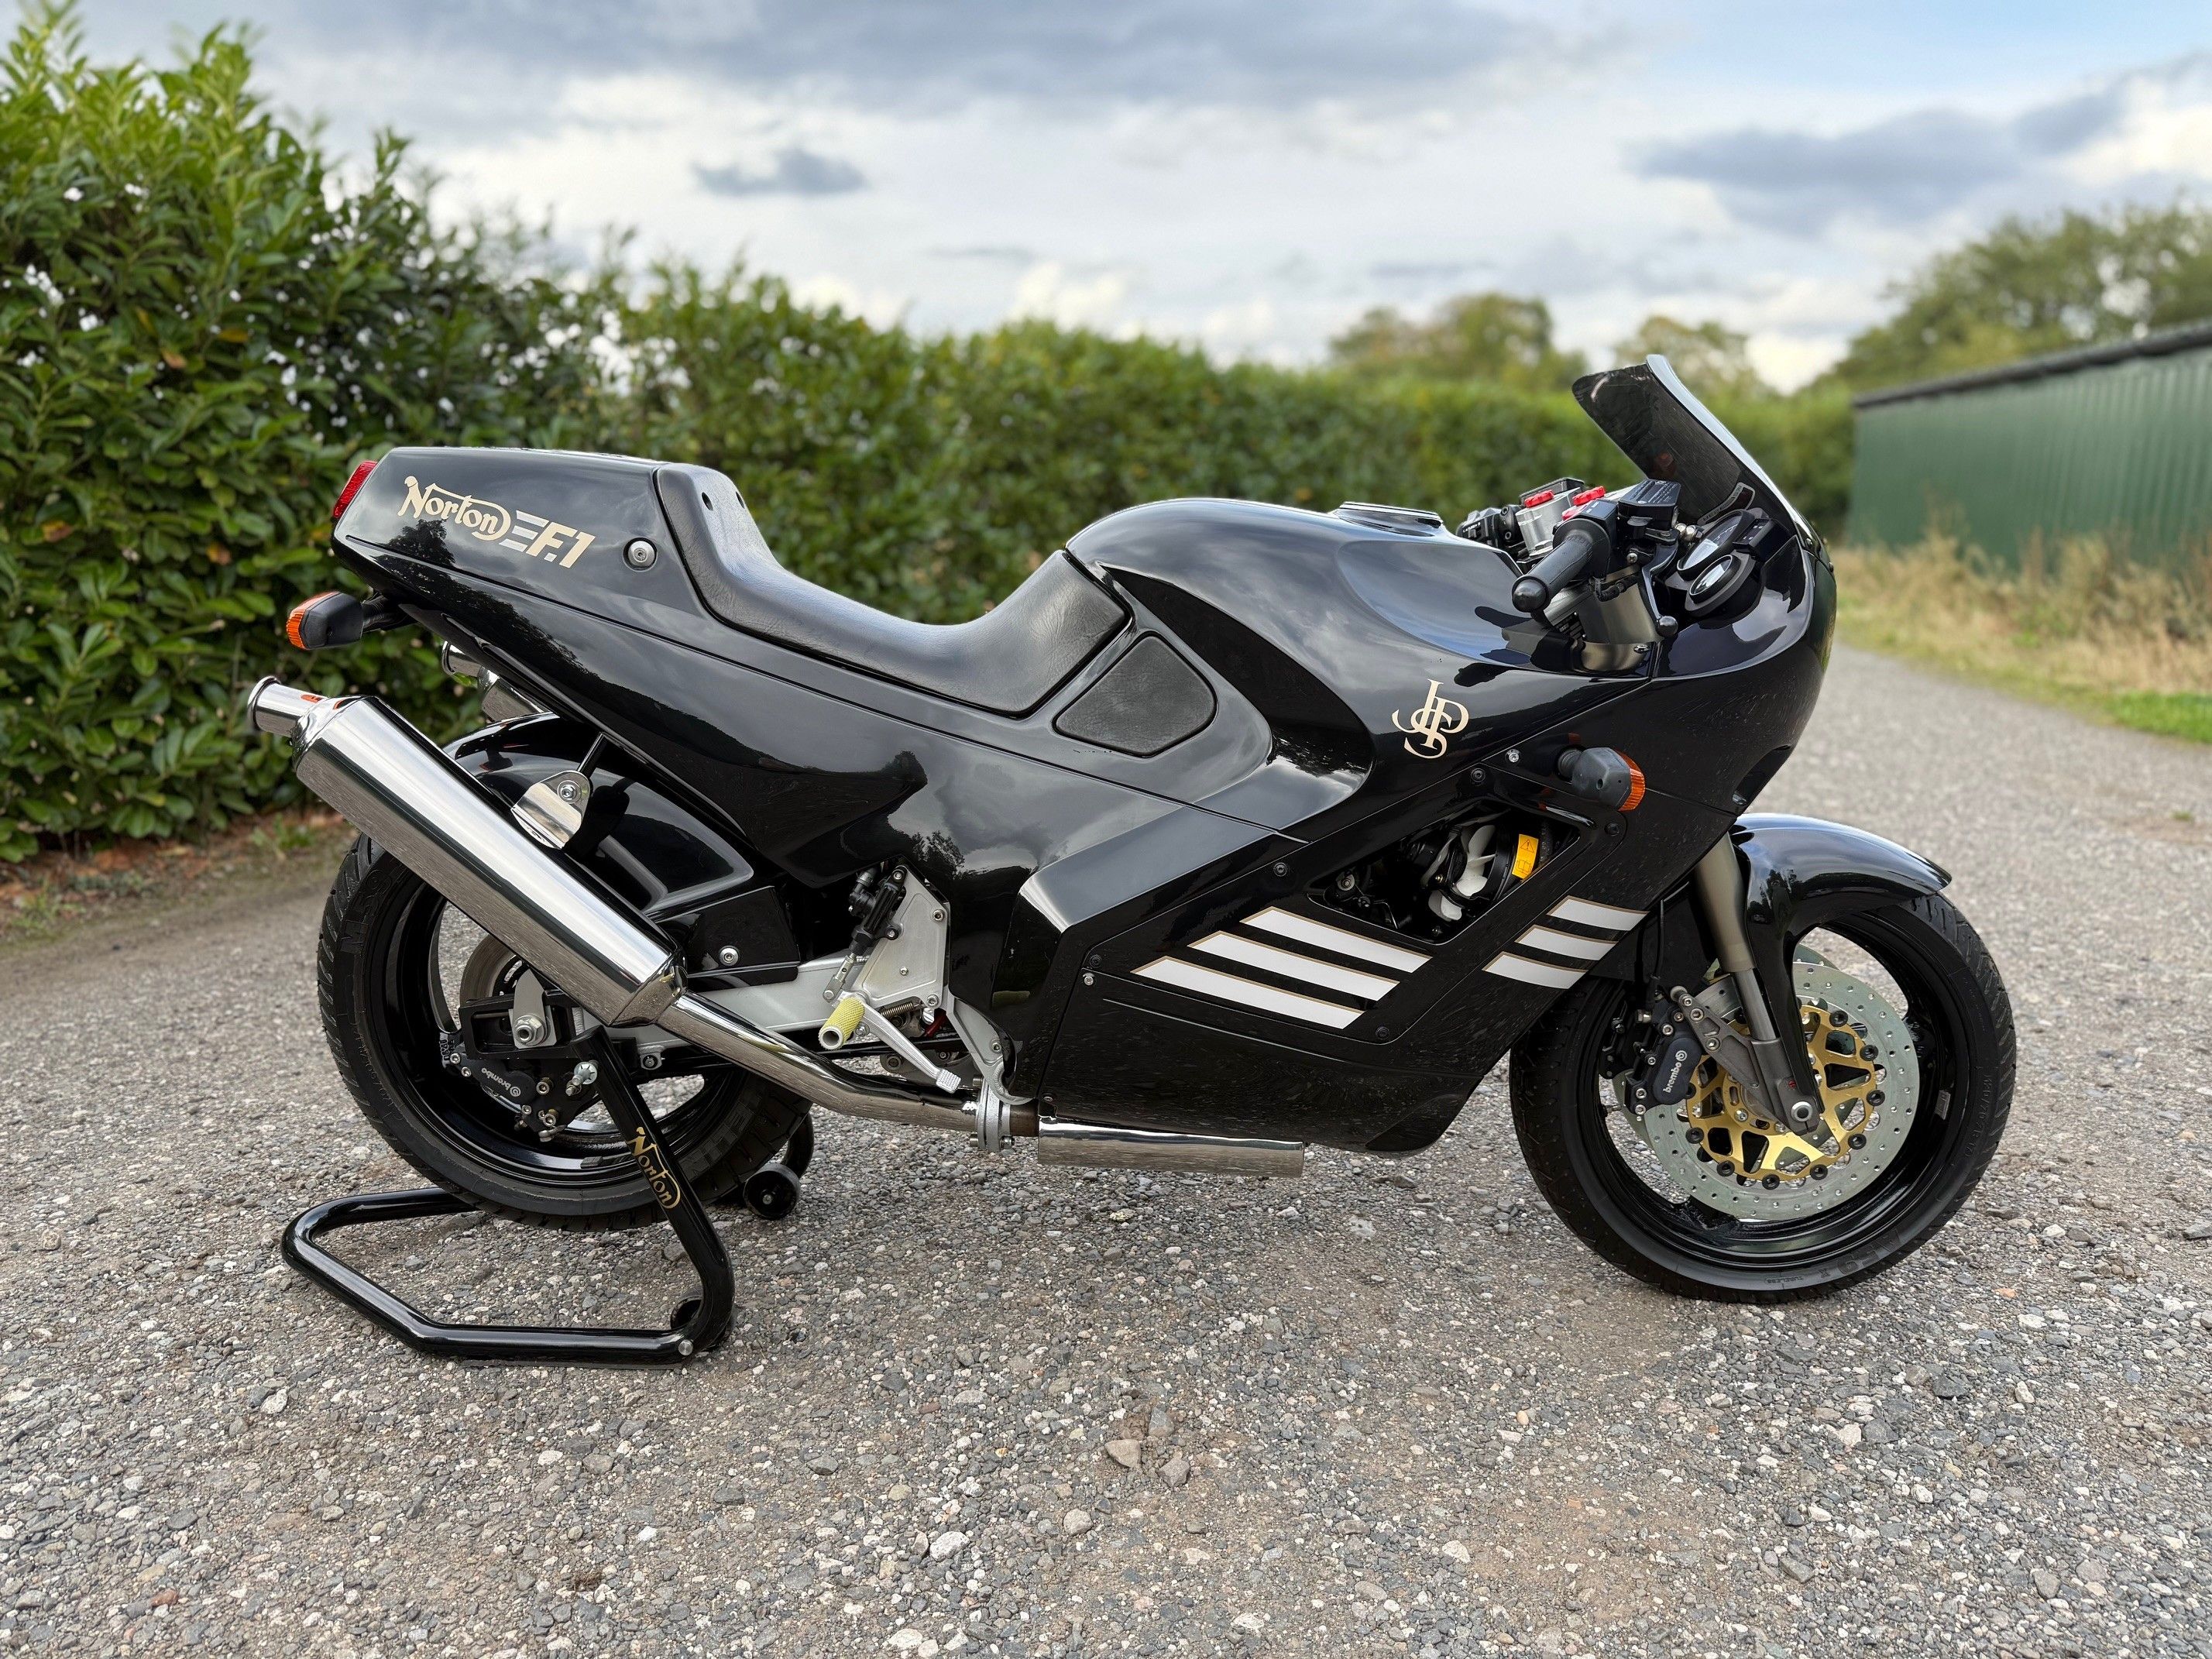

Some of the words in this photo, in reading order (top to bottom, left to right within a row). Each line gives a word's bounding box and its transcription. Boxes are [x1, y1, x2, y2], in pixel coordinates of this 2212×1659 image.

[397, 476, 511, 541] Norton
[481, 1067, 512, 1091] brembo
[1663, 1062, 1682, 1093] brembo
[625, 1126, 681, 1209] Norton
